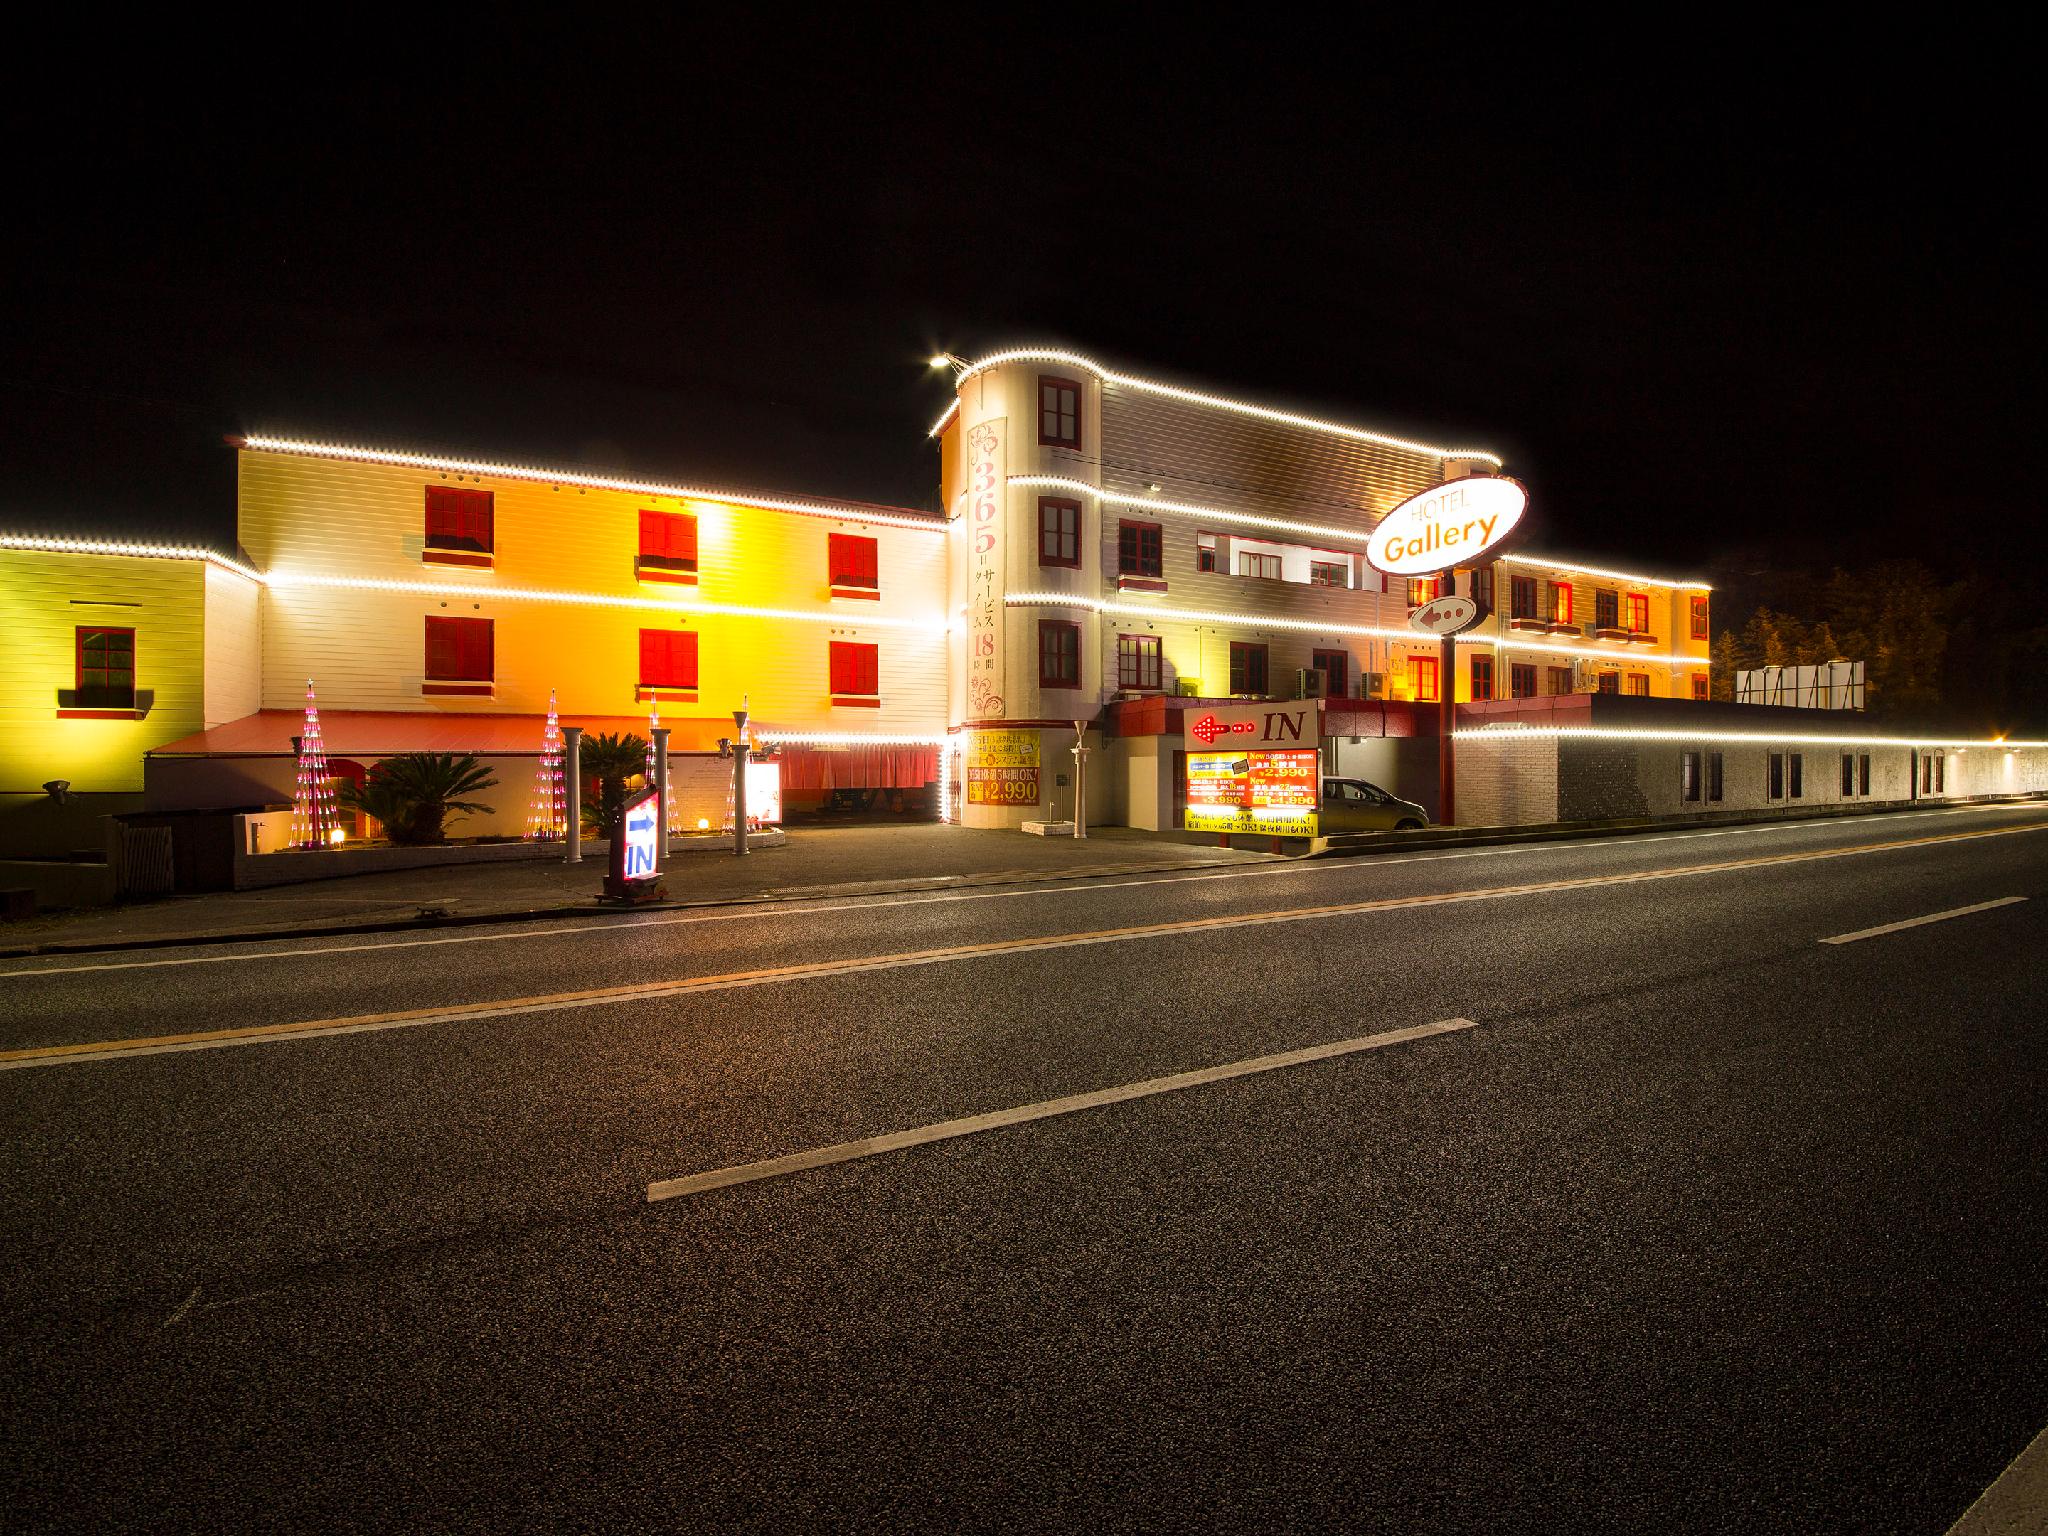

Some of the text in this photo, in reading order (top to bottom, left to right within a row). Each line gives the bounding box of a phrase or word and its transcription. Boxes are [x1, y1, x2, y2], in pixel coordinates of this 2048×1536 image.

[1411, 488, 1472, 521] HOTEL
[1384, 512, 1499, 563] Gallery
[1260, 711, 1307, 742] IN
[984, 781, 1037, 801] ¥2,990
[627, 843, 653, 876] IN
